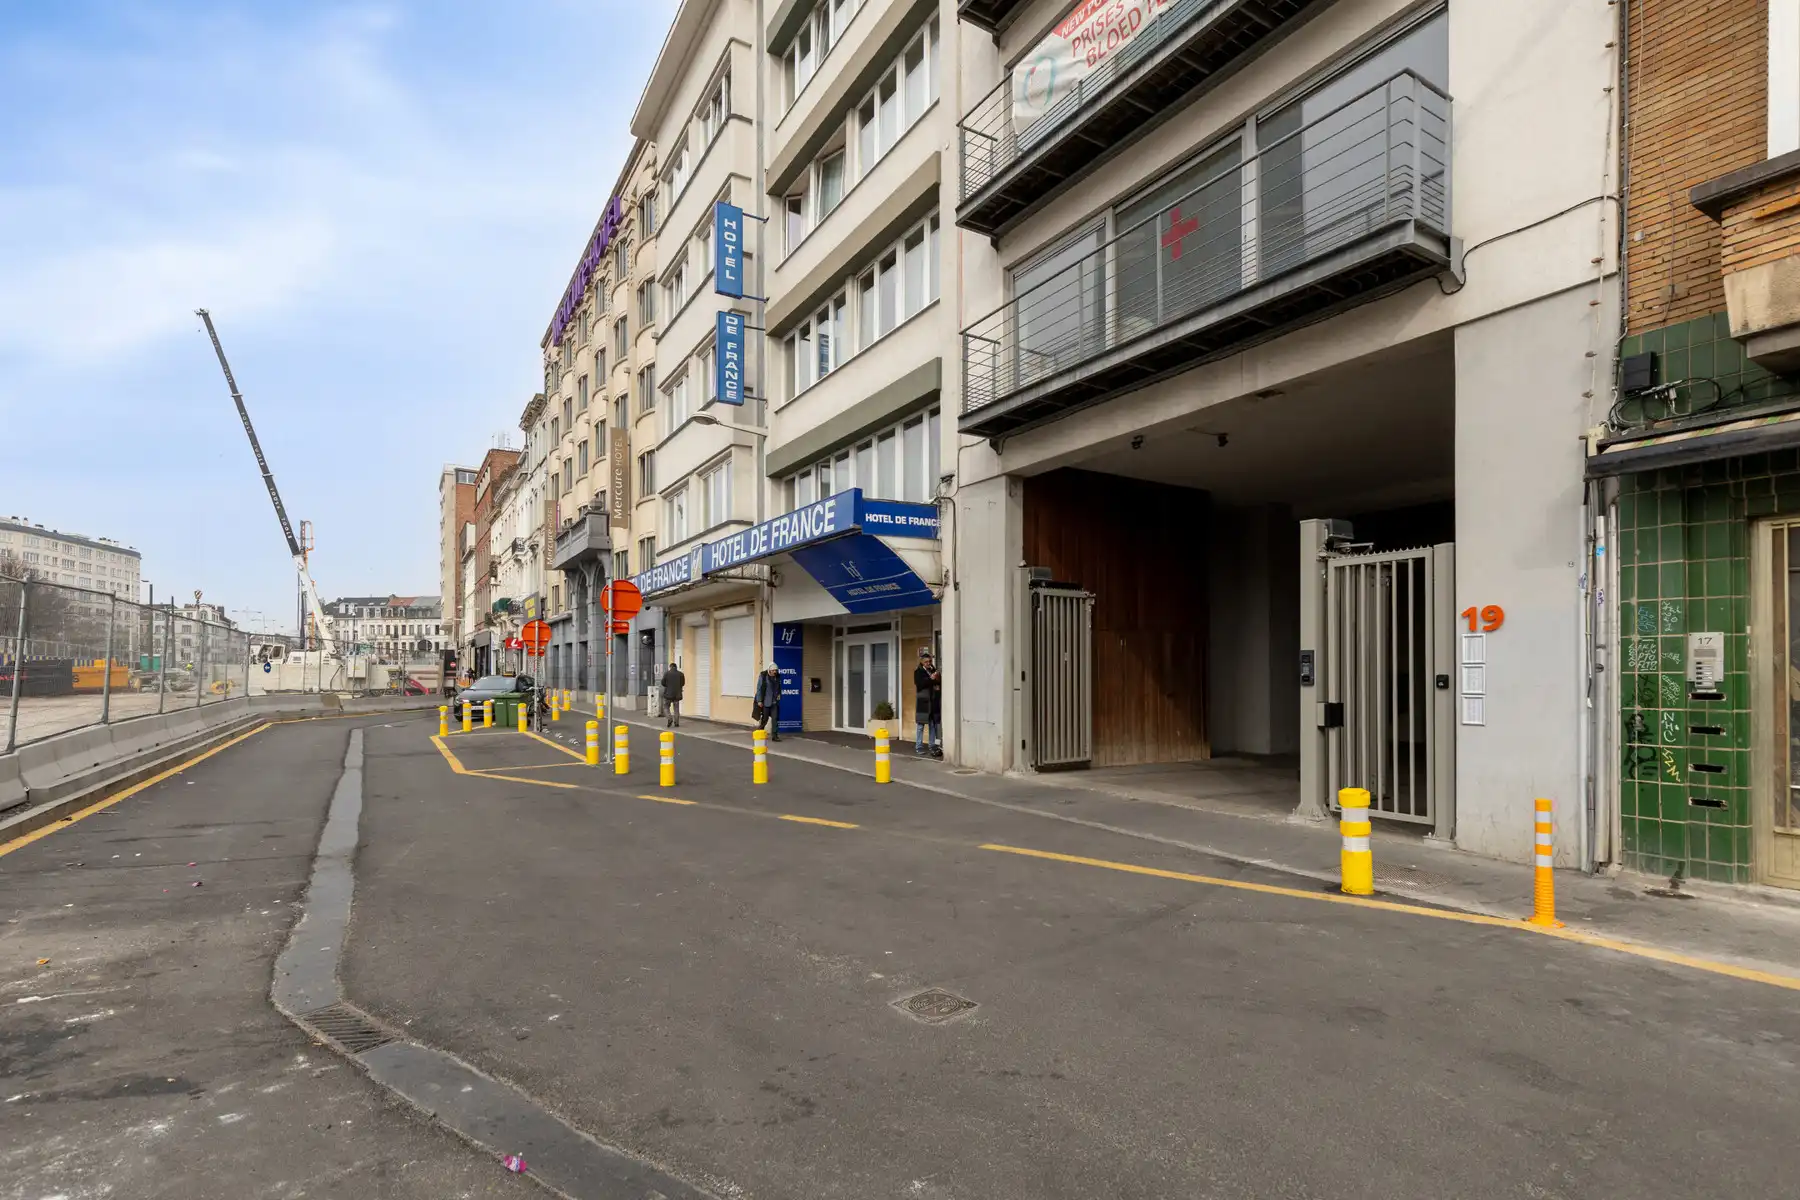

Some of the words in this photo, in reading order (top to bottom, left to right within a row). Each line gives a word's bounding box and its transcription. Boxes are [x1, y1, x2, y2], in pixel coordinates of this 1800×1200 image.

[1071, 2, 1125, 58] PRISES
[724, 218, 737, 280] HOTEL
[725, 315, 738, 335] DE
[725, 341, 739, 399] FRANCE
[615, 437, 623, 466] HOTEL
[614, 470, 623, 519] Mercure
[711, 534, 747, 568] HOTEL
[750, 524, 769, 556] DE
[771, 499, 837, 549] FRANCE
[865, 513, 894, 524] HOTEL
[895, 515, 907, 525] DE
[908, 516, 942, 527] FRANCE
[640, 571, 652, 593] DE
[652, 556, 689, 589] FRANCE
[1461, 604, 1505, 633] 19
[781, 628, 796, 644] hf
[1697, 636, 1713, 645] 17
